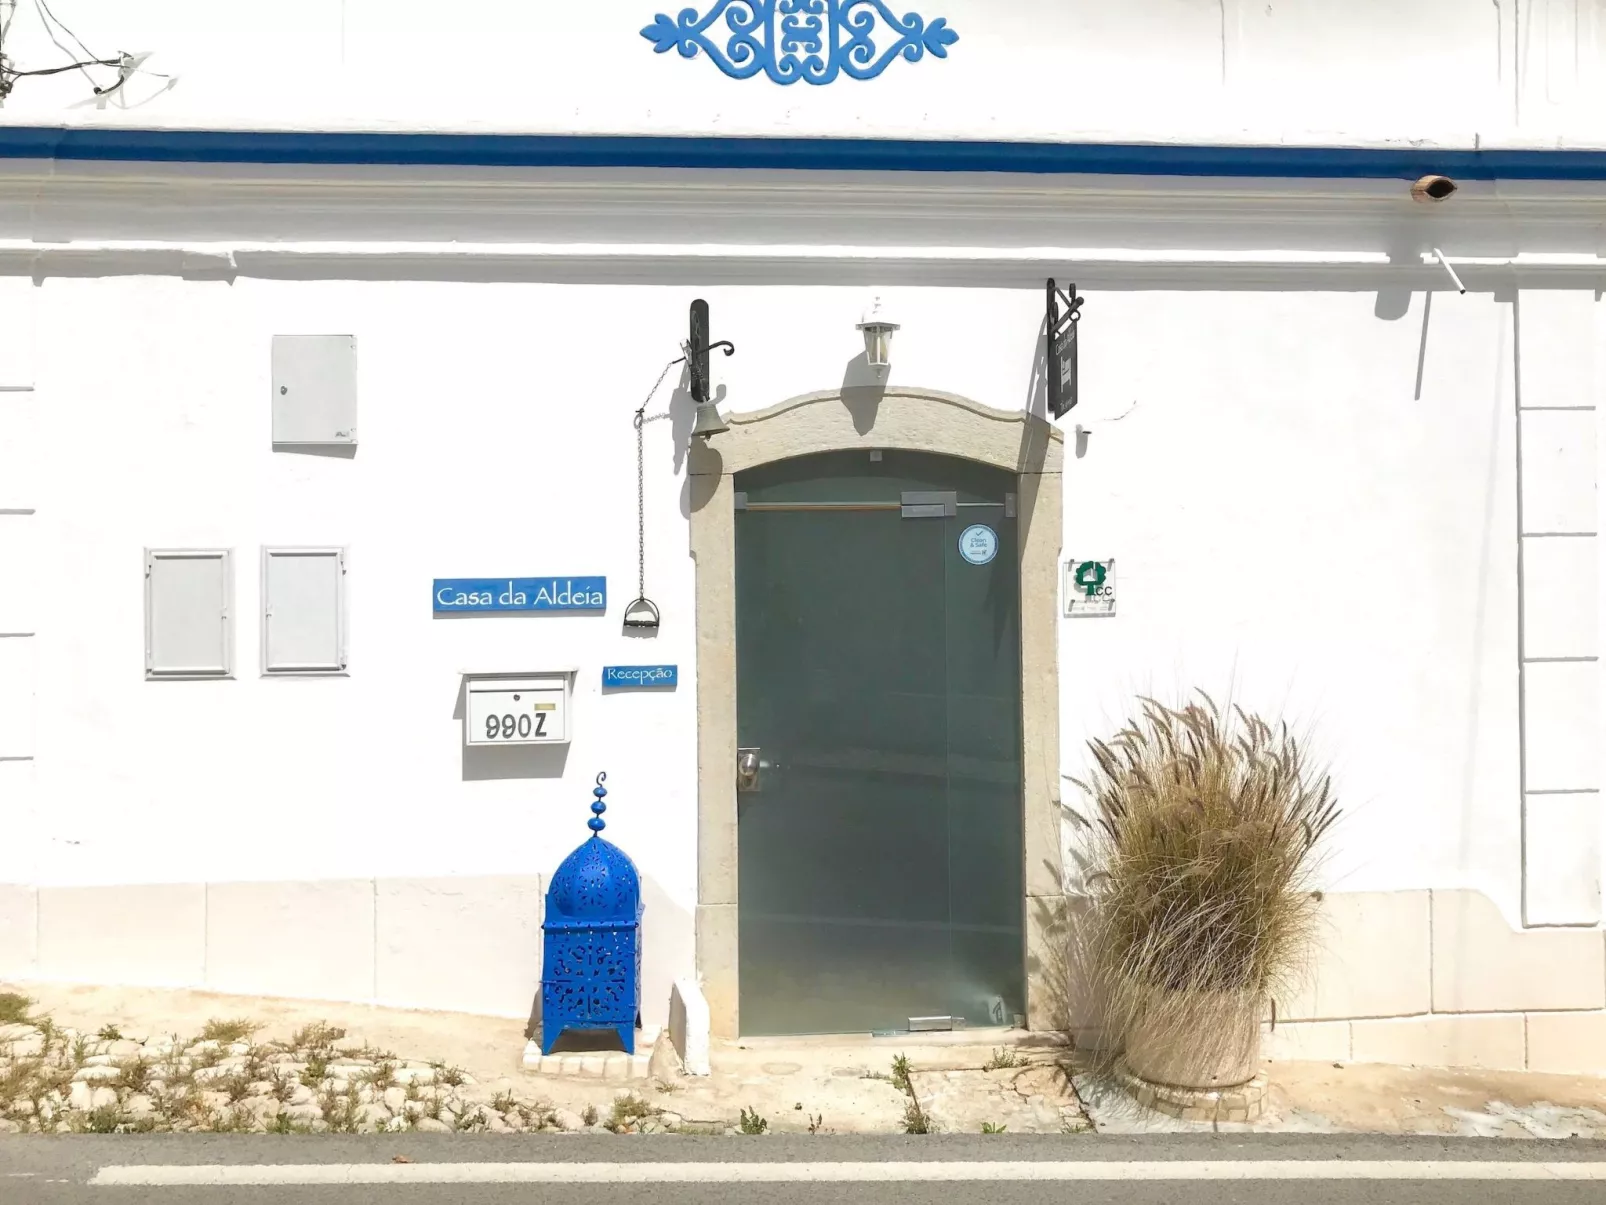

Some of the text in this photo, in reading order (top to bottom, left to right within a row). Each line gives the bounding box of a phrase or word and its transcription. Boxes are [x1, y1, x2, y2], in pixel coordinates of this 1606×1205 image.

[437, 580, 603, 605] Casa da Aldeia
[607, 667, 673, 685] Recepção
